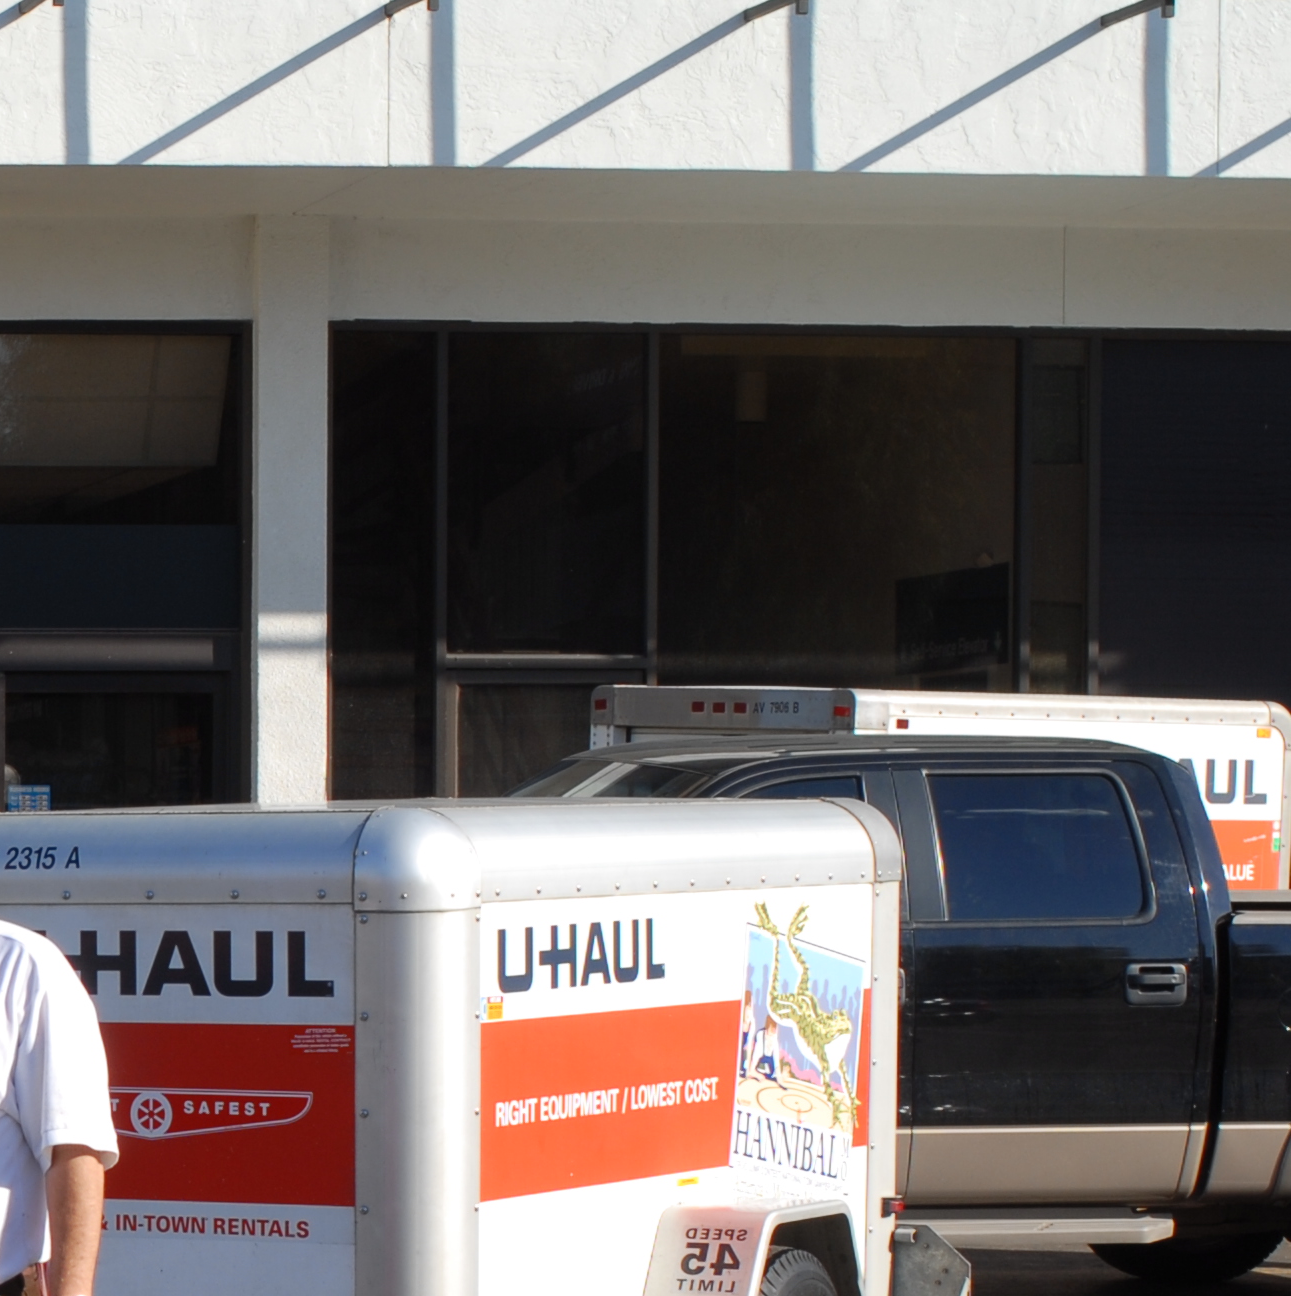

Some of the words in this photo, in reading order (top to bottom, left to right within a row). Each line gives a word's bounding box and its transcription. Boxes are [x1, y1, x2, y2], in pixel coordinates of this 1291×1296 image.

[753, 702, 765, 714] AV
[793, 701, 799, 714] B
[5, 846, 57, 870] 2315
[65, 846, 81, 869] A
[34, 930, 335, 998] -HAUL
[497, 918, 666, 994] U-HAUL
[183, 1100, 270, 1116] SAFEST
[495, 1098, 537, 1128] RIGHT
[540, 1088, 619, 1122] EQUIPMENT
[622, 1087, 629, 1114] /
[631, 1081, 683, 1111] LOWEST
[685, 1077, 719, 1105] COST
[733, 1109, 839, 1180] HANNIBAL
[116, 1214, 207, 1234] IN-TOWN
[213, 1218, 310, 1239] RENTALS
